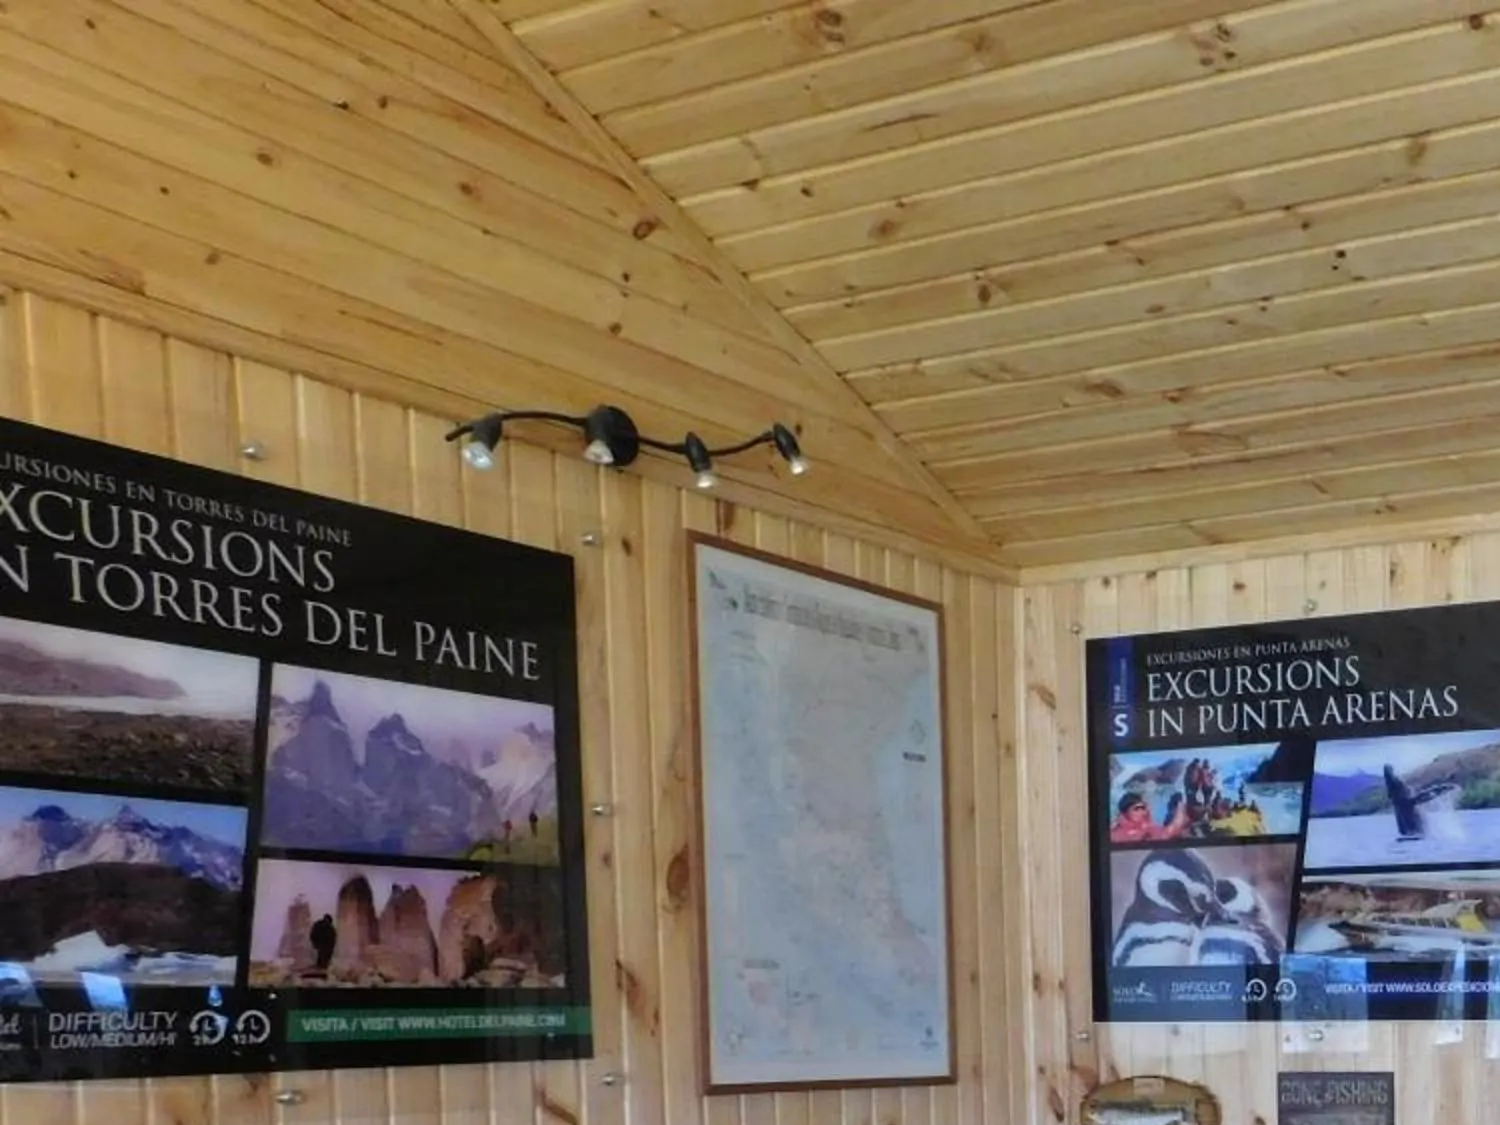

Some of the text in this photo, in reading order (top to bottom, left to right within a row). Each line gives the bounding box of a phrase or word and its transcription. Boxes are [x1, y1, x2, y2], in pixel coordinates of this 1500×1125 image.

[126, 480, 156, 503] EN
[162, 489, 245, 523] TORRES
[253, 509, 290, 533] DEL
[296, 520, 352, 547] PAINE
[53, 551, 283, 637] TORRES
[304, 599, 397, 656] DEL
[413, 621, 541, 681] PAINE
[1146, 636, 1350, 667] EXCURSIONES EN PUNTA ARENAS
[1147, 655, 1361, 702] EXCURSIONS
[1113, 712, 1129, 738] S
[1147, 684, 1459, 738] IN PUNTA ARENAS
[50, 1011, 178, 1033] DIFFICULTY
[302, 1017, 348, 1033] VISITA
[359, 1016, 396, 1032] VISIT
